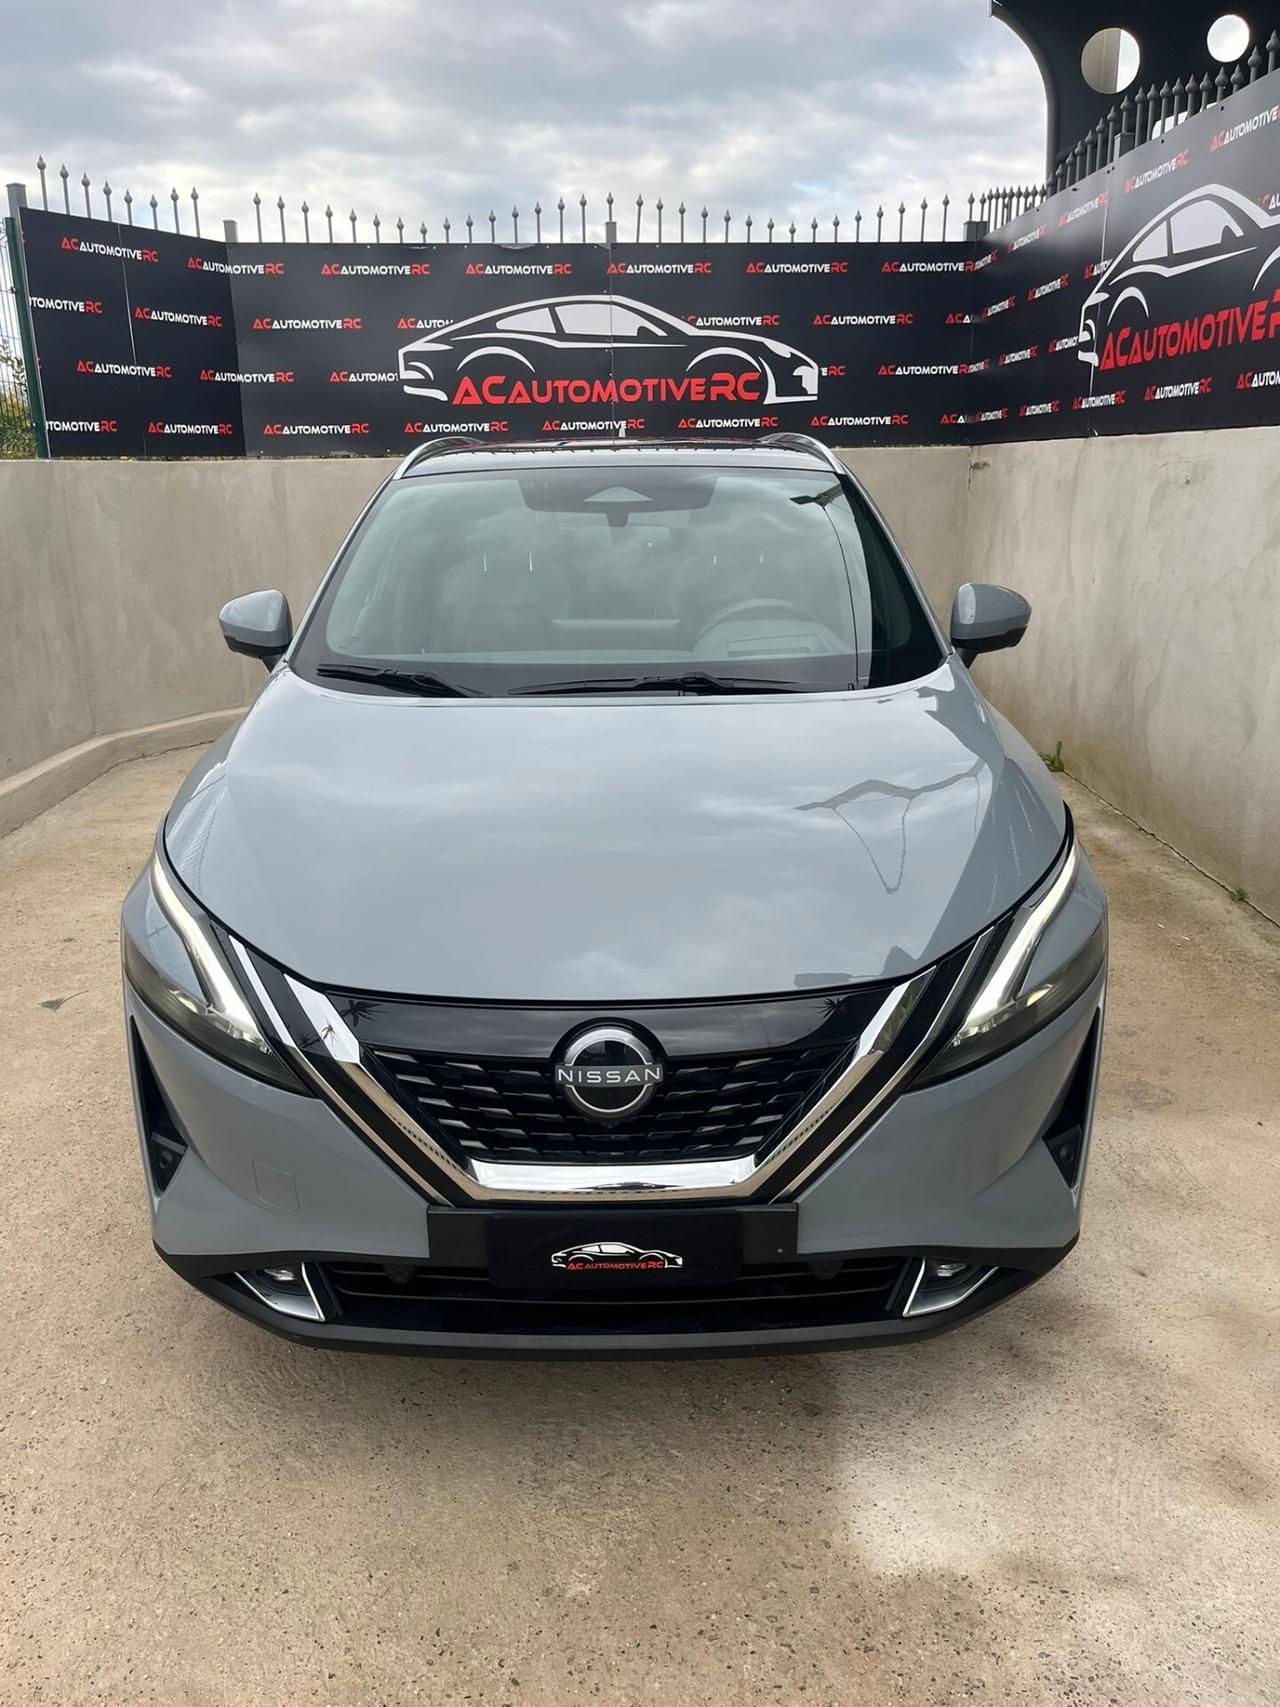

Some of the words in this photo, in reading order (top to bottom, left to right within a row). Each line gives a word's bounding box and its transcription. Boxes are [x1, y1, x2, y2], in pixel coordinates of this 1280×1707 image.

[1210, 105, 1280, 152] ACAUTOMOTIVE
[61, 237, 158, 263] ACAUTOMOTIVERC
[187, 257, 284, 275] ACAUTOMOTIVERC
[320, 264, 431, 276] ACAUTOMOTIVERC
[465, 263, 572, 275] ACAUTOMOTIVERC
[607, 262, 712, 274] ACAUTOMOTIVERC
[746, 261, 848, 273] ACAUTOMOTIVERC
[135, 307, 222, 327] ACAUTOMOTIVERC
[813, 313, 913, 325] ACAUTOMOTIVERC
[252, 318, 362, 330] ACAUTOMOTIVERC
[76, 360, 172, 379] ACAUTOMOTIVERC
[200, 370, 294, 382] ACAUTOMOTIVERC
[452, 373, 761, 405] ACAUTOMOTIVERC
[542, 419, 645, 431] ACAUTOMOTIVERC
[678, 416, 778, 428] ACAUTOMOTIVERC
[810, 414, 909, 427] ACAUTOMOTIVERC
[148, 422, 233, 434] ACAUTOMOTIVERC
[263, 423, 369, 435] ACAUTOMOTIVERC
[404, 421, 508, 433] ACAUTOMOTIVERC
[558, 1067, 660, 1083] NISSAN
